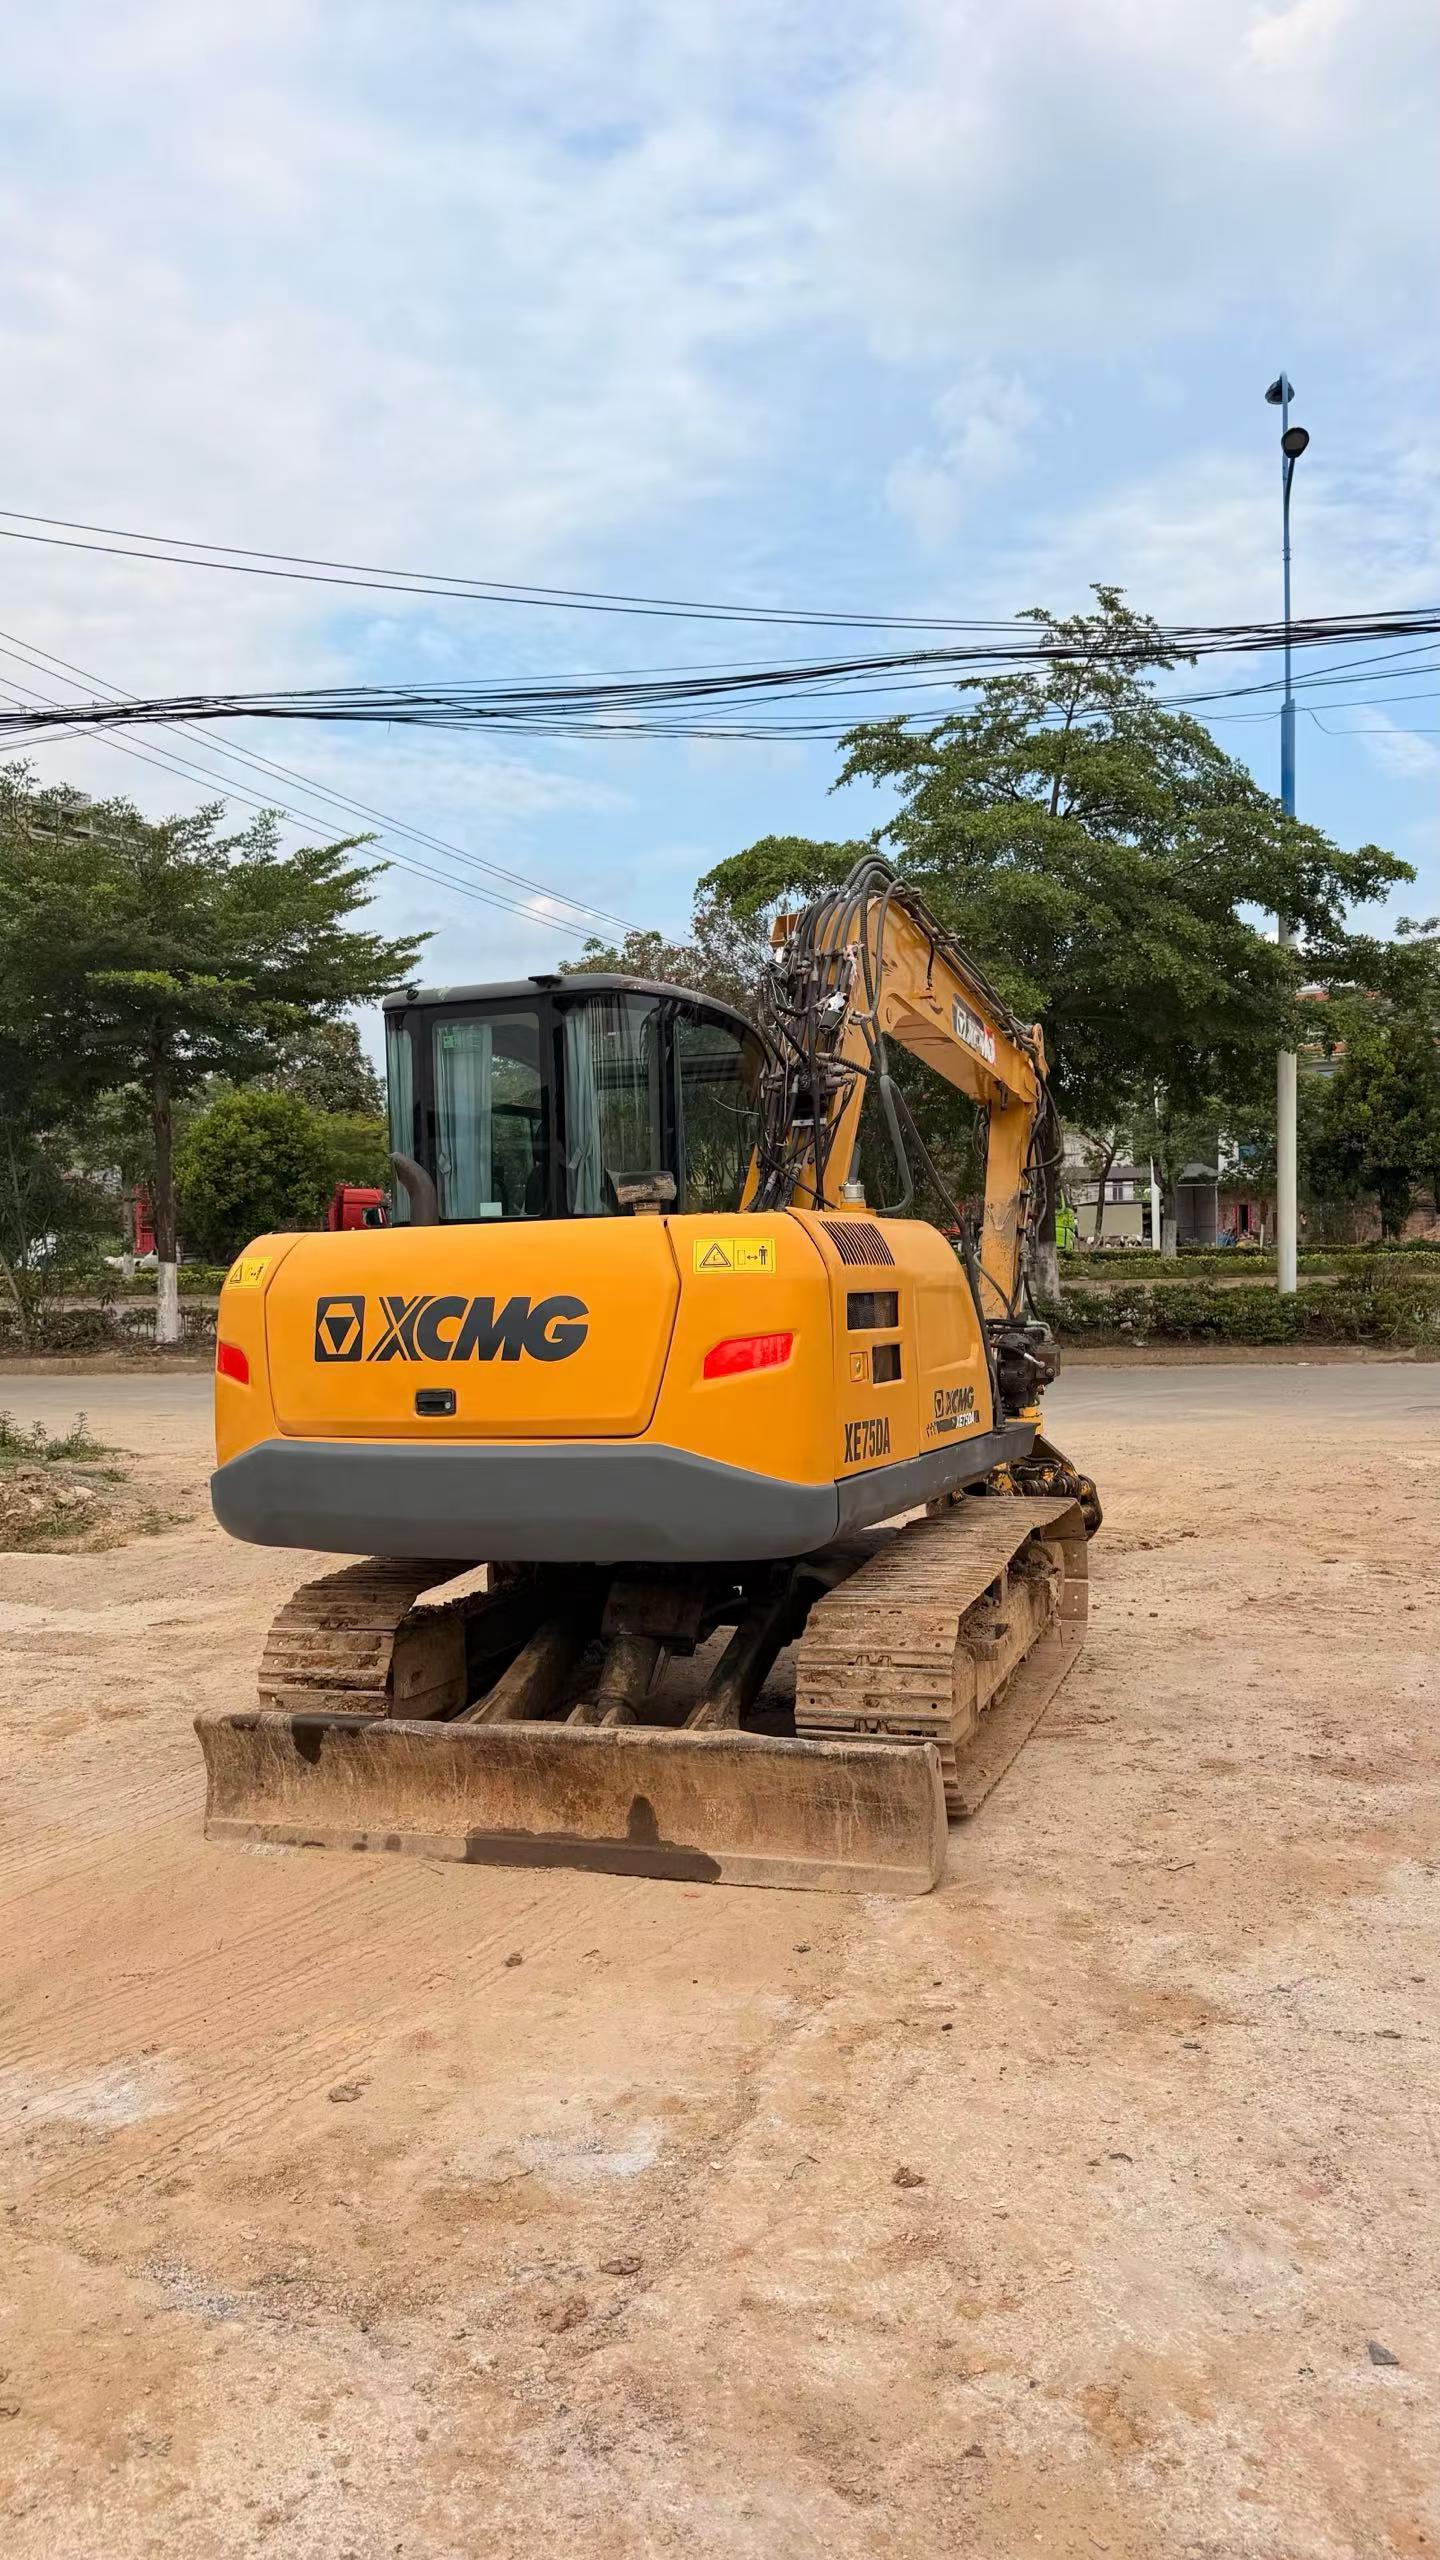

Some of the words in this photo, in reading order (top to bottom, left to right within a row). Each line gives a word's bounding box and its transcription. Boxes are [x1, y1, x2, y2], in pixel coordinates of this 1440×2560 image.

[366, 1295, 589, 1361] XCMG
[945, 1386, 974, 1415] XCMG
[844, 1417, 891, 1463] XE75DA
